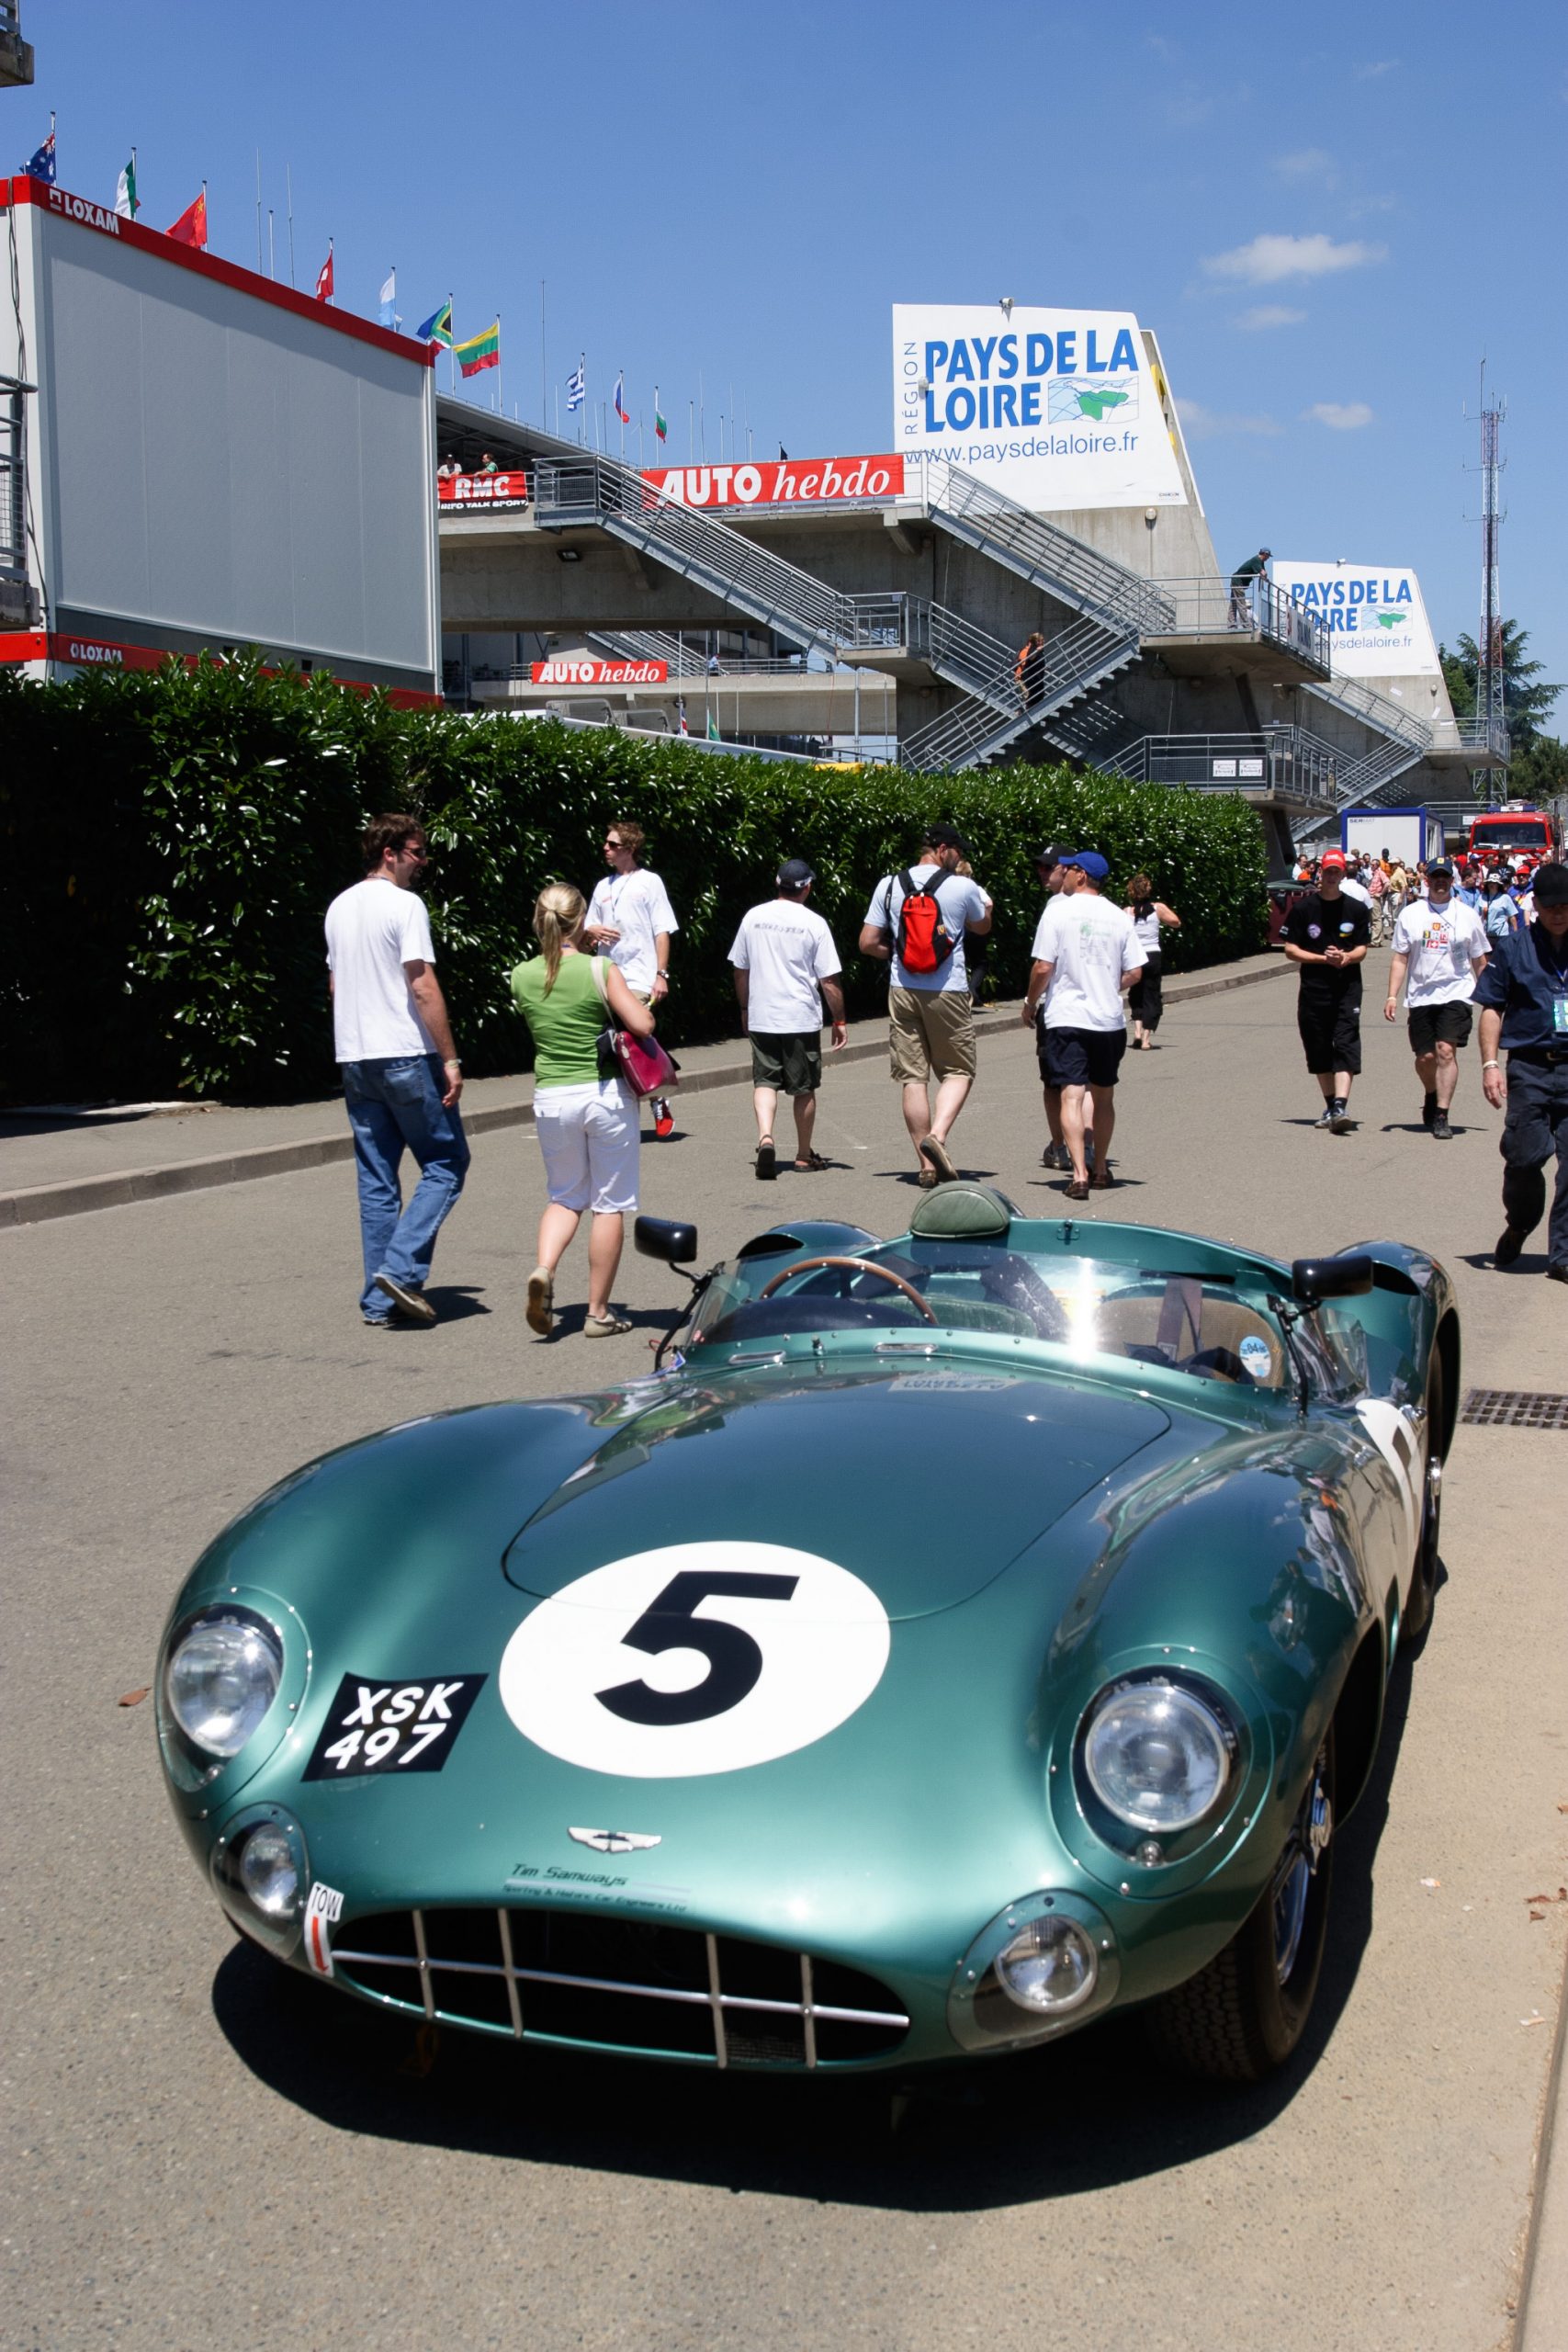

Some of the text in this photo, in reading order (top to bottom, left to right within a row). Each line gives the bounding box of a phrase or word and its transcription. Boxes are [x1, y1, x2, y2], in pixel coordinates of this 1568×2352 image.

[64, 194, 120, 235] LOXAM
[925, 329, 1139, 383] PAYS DE LA
[903, 341, 918, 435] RÉGION
[925, 382, 1042, 433] LOIRE
[905, 431, 1138, 465] www.paysdelaloire.fr
[455, 476, 510, 500] RMC
[660, 460, 889, 504] AUTO hebdo
[1292, 579, 1413, 608] PAYS DE LA
[1305, 607, 1358, 632] OIRE
[539, 662, 660, 683] AUTO hebdo
[594, 1571, 800, 1725] 5
[342, 1682, 464, 1725] XSK
[324, 1723, 446, 1770] 497
[513, 1863, 628, 1886] Tim Samways
[312, 1886, 341, 1917] TOW
